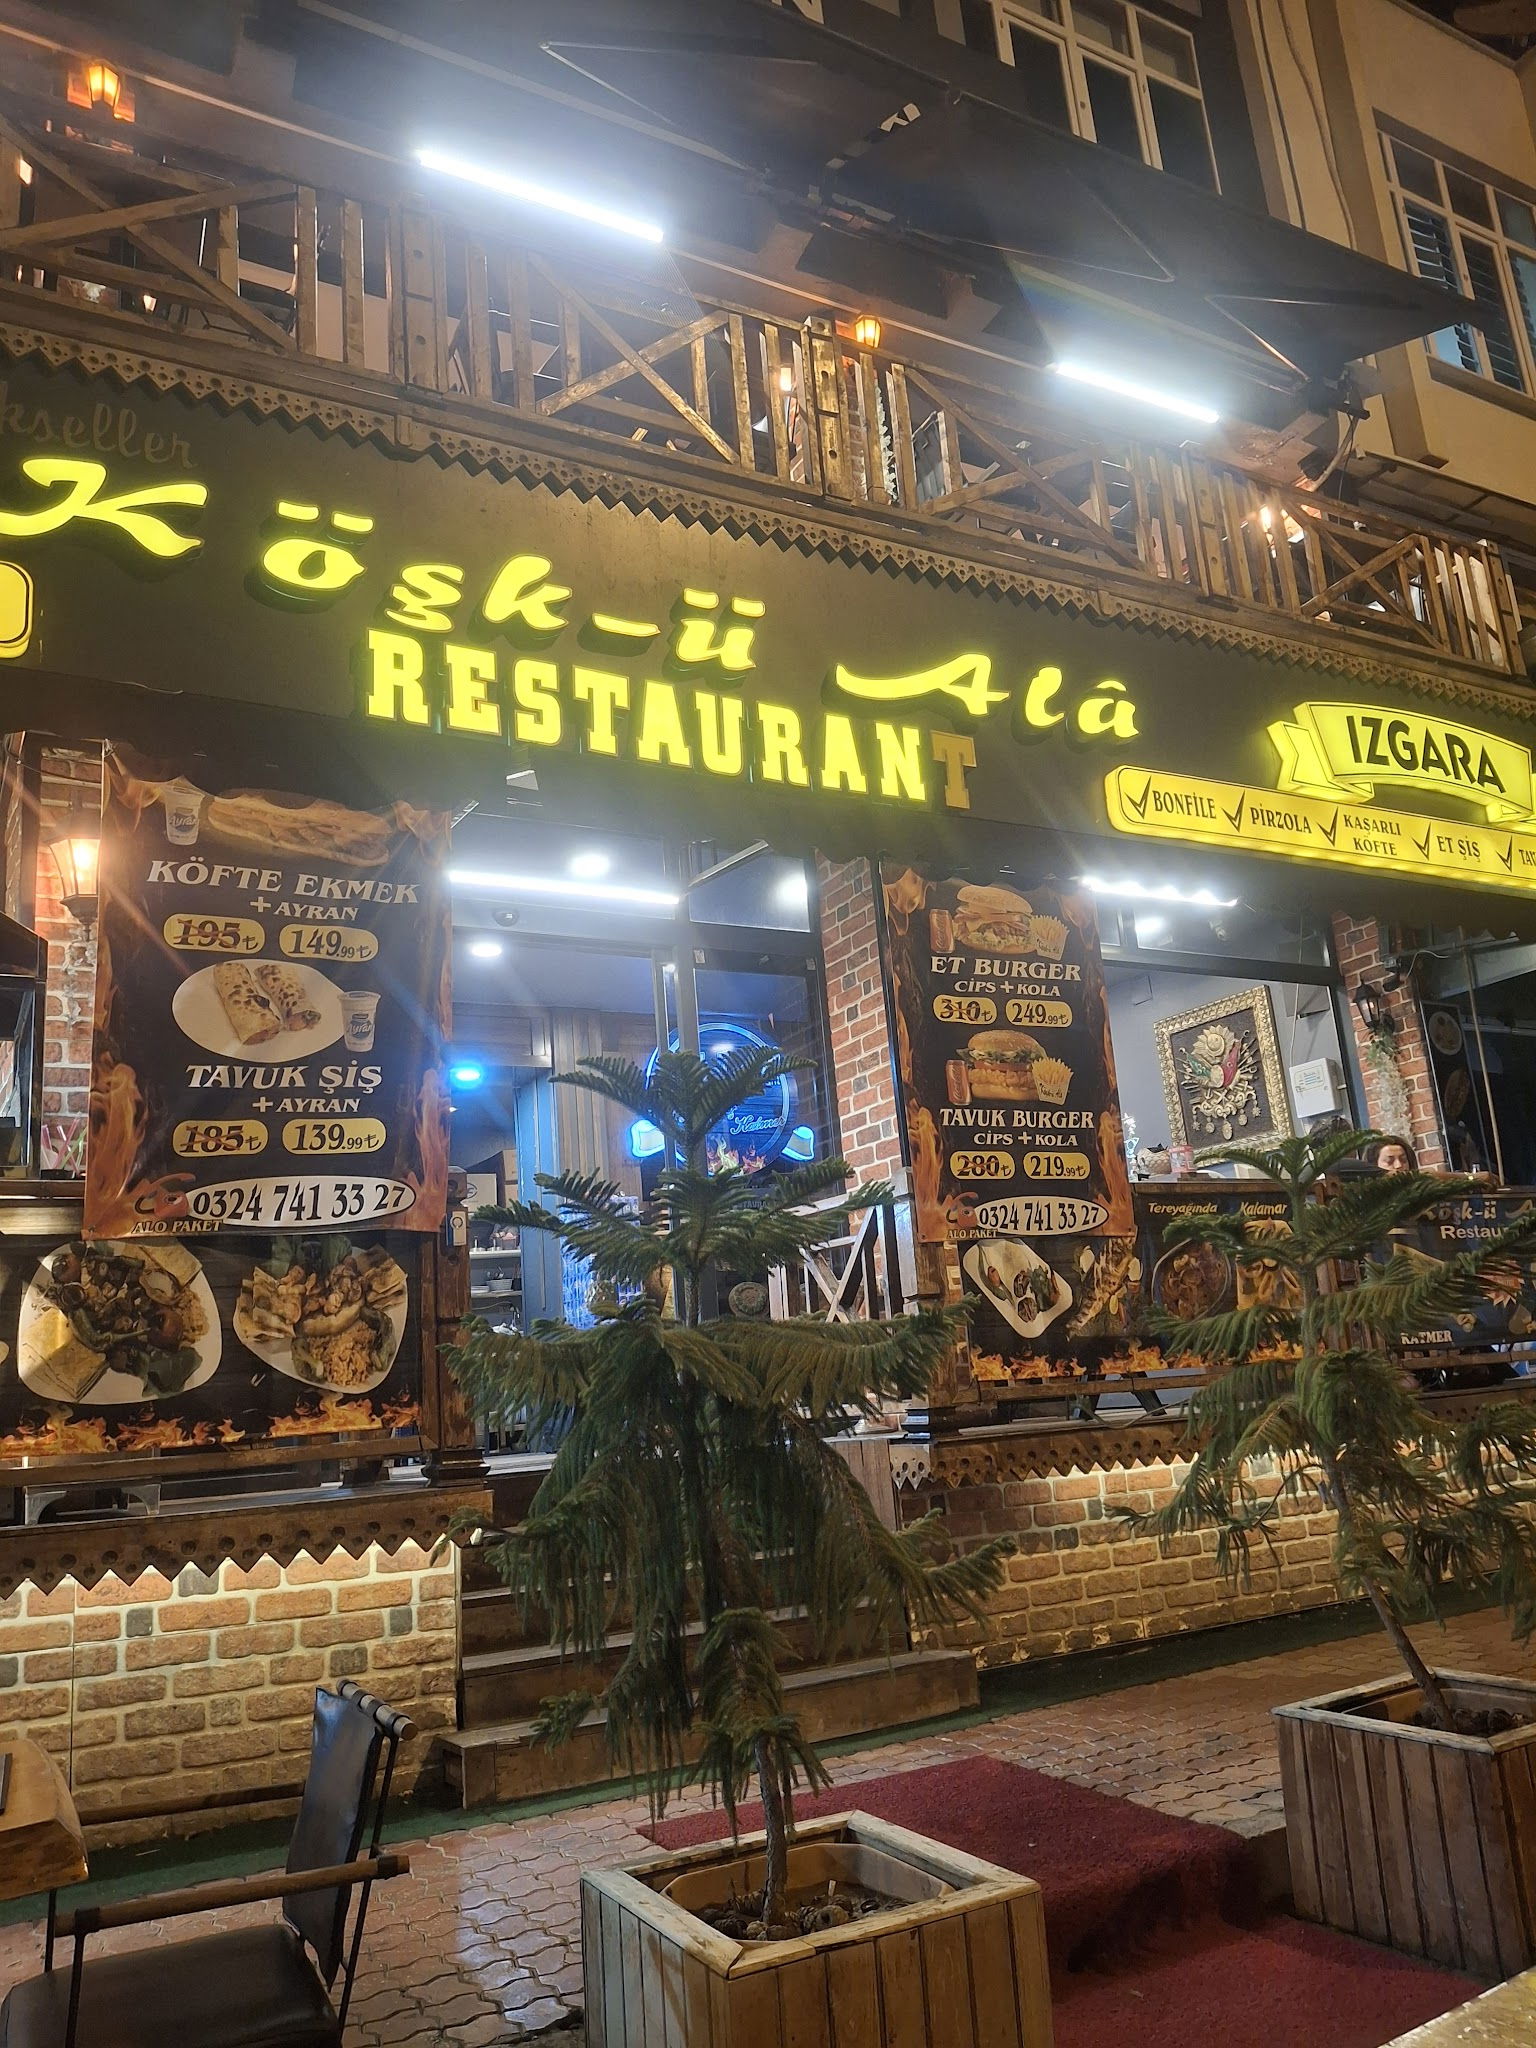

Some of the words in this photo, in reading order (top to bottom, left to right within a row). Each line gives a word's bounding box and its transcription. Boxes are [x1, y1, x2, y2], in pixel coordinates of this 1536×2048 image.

[836, 653, 1139, 738] Alâ
[367, 629, 977, 809] RESTAURANT
[1346, 714, 1507, 795] IZGARA
[1152, 789, 1217, 820] BONFİLE
[1251, 803, 1312, 834] PİRZOLA
[1437, 835, 1455, 857] ET
[147, 856, 282, 892] KÖFTE
[294, 873, 420, 904] EKMEK
[931, 956, 966, 974] ET
[974, 958, 1081, 981] BURGER
[185, 1064, 308, 1090] TAVUK
[318, 1060, 383, 1094] ŞİŞ
[940, 1109, 1006, 1127] TAVUK
[1012, 1110, 1094, 1129] BURGER
[192, 1183, 262, 1221] 0324
[272, 1180, 322, 1220] 741
[332, 1183, 364, 1215] 33
[374, 1184, 406, 1210] 27
[1148, 1202, 1219, 1216] Tereyağında
[1241, 1201, 1288, 1215] Kalamar
[131, 1221, 168, 1233] ALO
[172, 1219, 223, 1233] PAKET
[979, 1203, 1020, 1231] 0324
[1024, 1202, 1053, 1231] 741
[1058, 1202, 1077, 1228] 33
[1081, 1204, 1099, 1225] 27
[948, 1229, 967, 1239] ALO
[970, 1229, 998, 1239] PAKET
